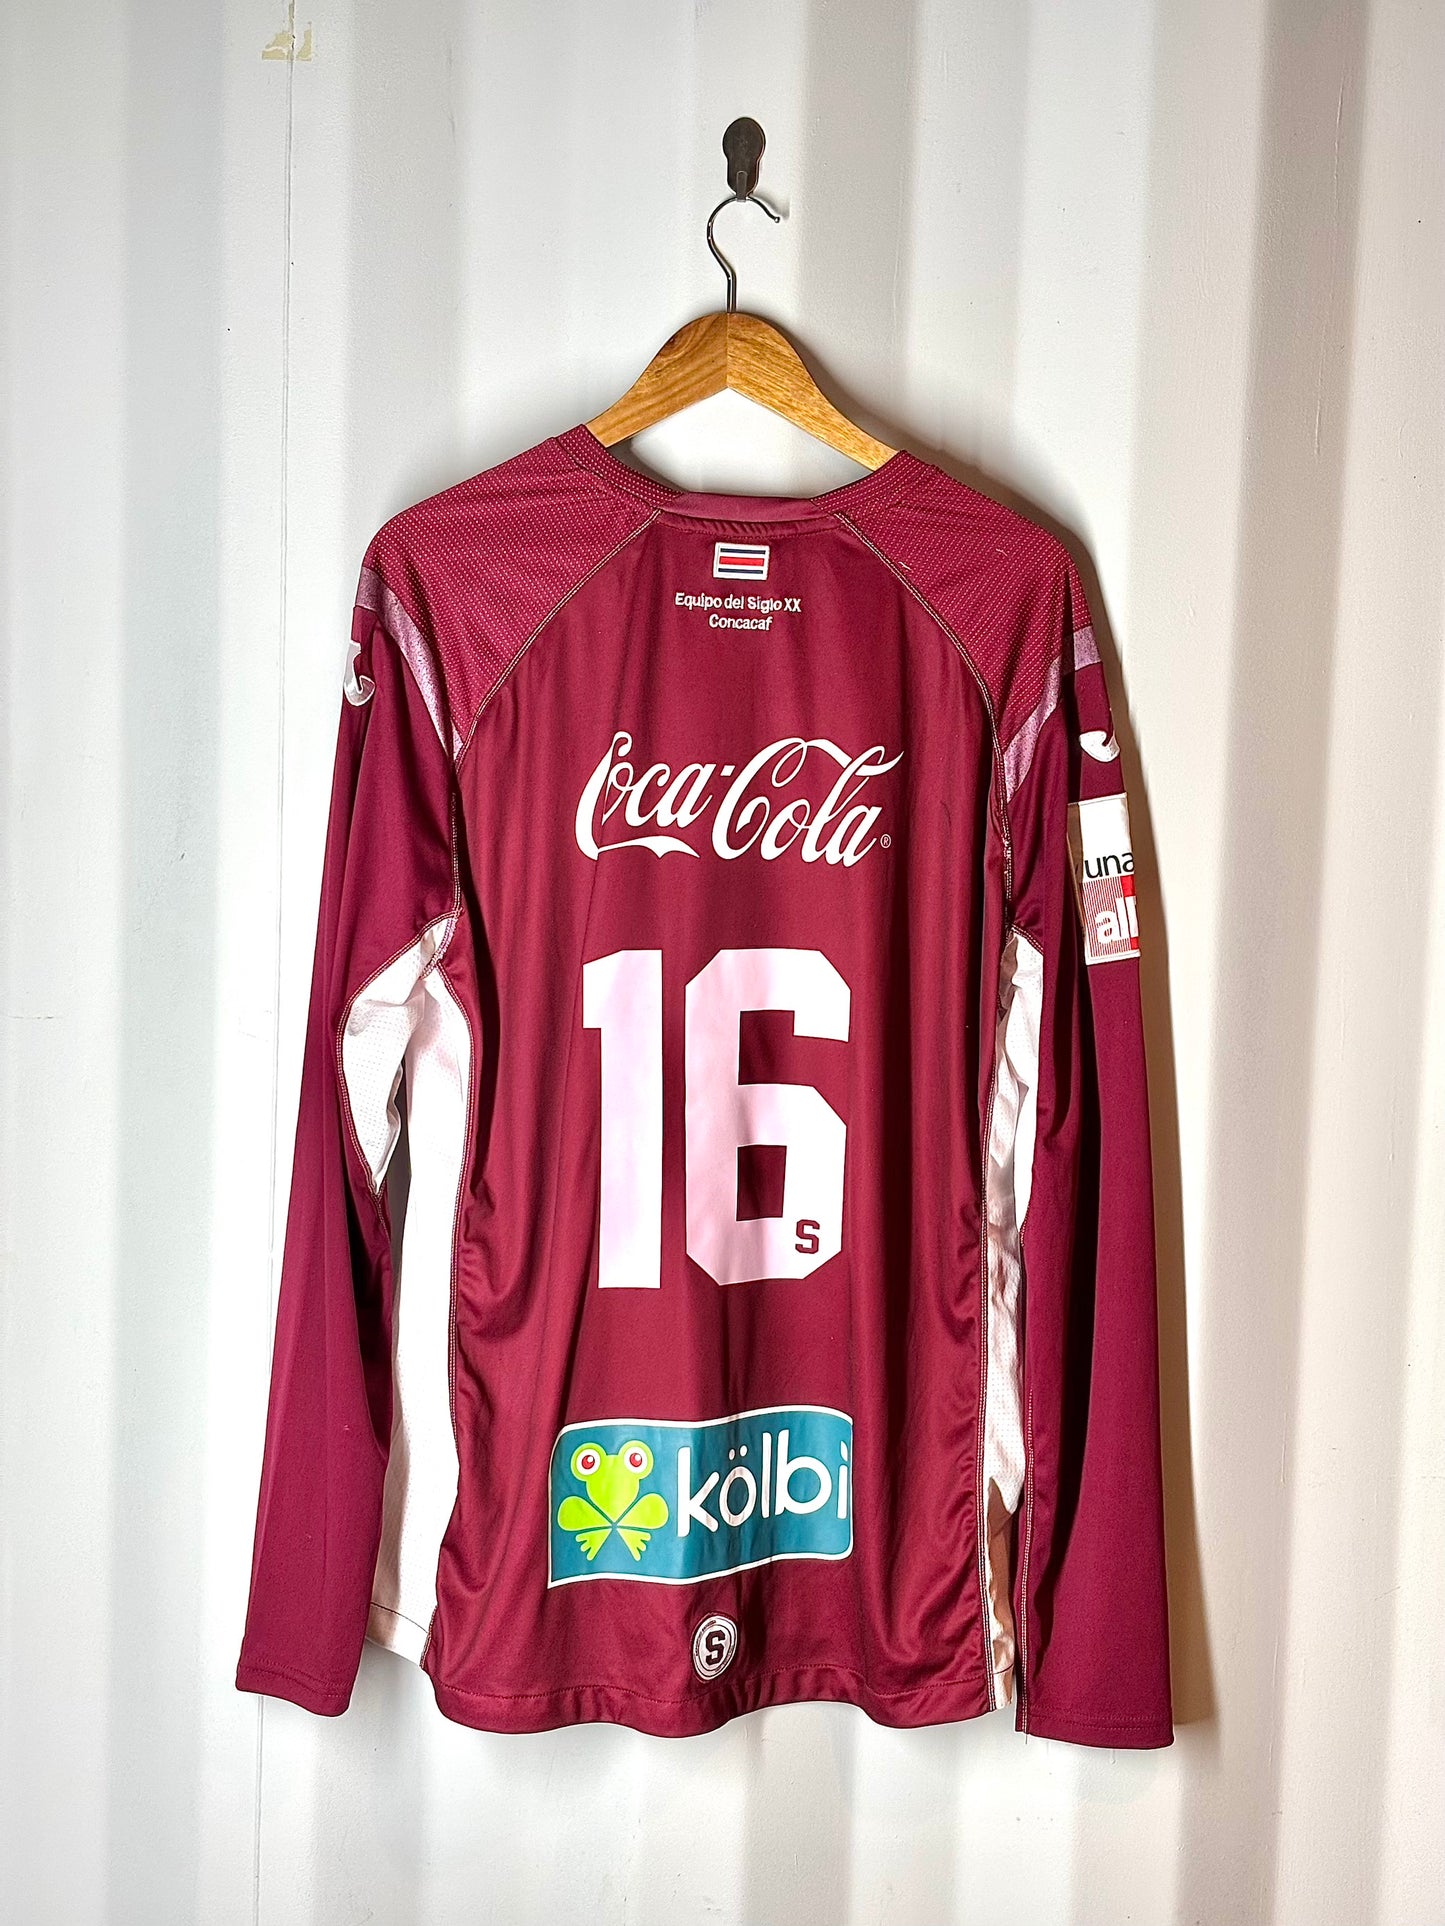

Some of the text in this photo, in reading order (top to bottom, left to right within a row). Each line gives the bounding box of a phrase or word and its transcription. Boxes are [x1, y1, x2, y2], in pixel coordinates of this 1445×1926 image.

[675, 592, 802, 614] Equipo del Siglo XX
[708, 613, 773, 631] Concacaf
[575, 731, 904, 868] Coca-Cola
[582, 948, 852, 1290] 16
[795, 1219, 820, 1254] S
[677, 1429, 848, 1538] kölbi
[705, 1629, 726, 1666] S
